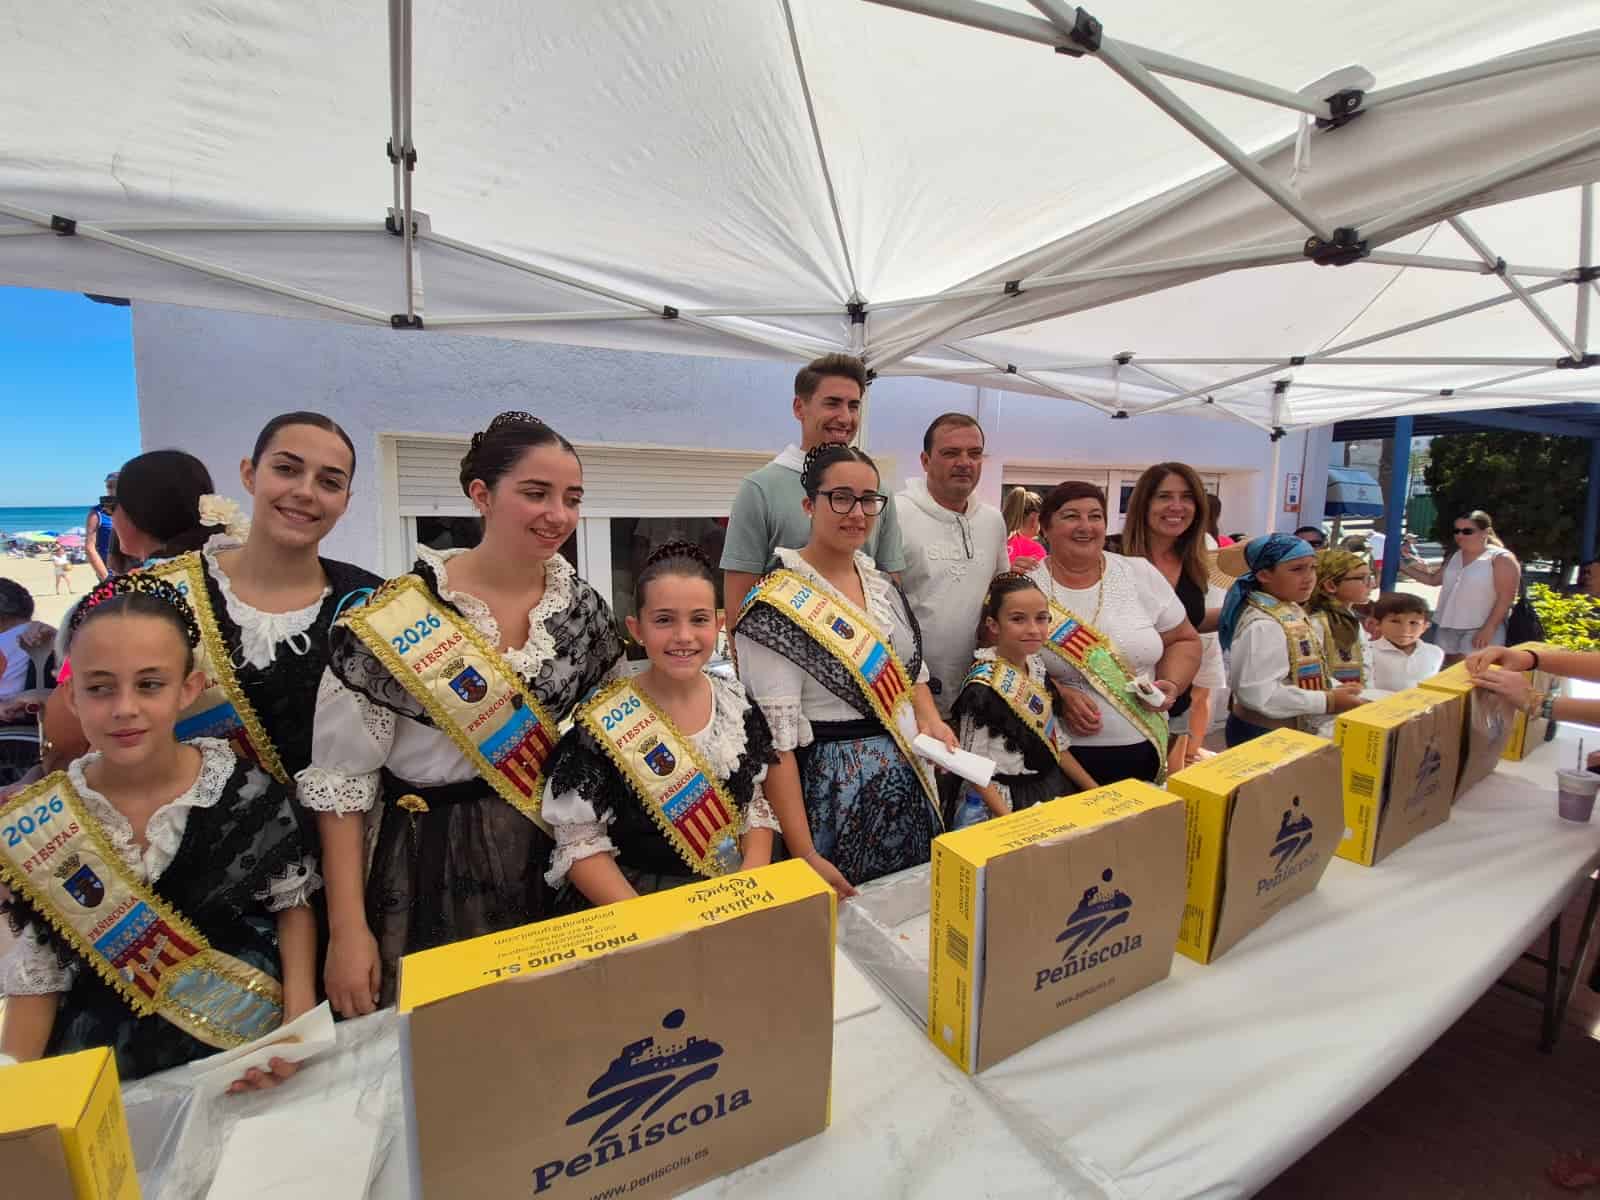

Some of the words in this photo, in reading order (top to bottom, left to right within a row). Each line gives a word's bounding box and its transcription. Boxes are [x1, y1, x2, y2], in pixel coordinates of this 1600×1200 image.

[391, 612, 441, 655] 2026
[412, 632, 463, 674] FIESTAS
[601, 695, 641, 731] 2026
[615, 712, 658, 750] FIESTAS
[2, 795, 64, 848] 2026
[23, 822, 80, 874] FIESTAS
[528, 949, 576, 968] PUIG
[587, 932, 640, 954] PIÑOL
[1033, 933, 1143, 993] Peñíscola
[483, 963, 521, 978] S.L.
[531, 1087, 752, 1195] Peñíscola
